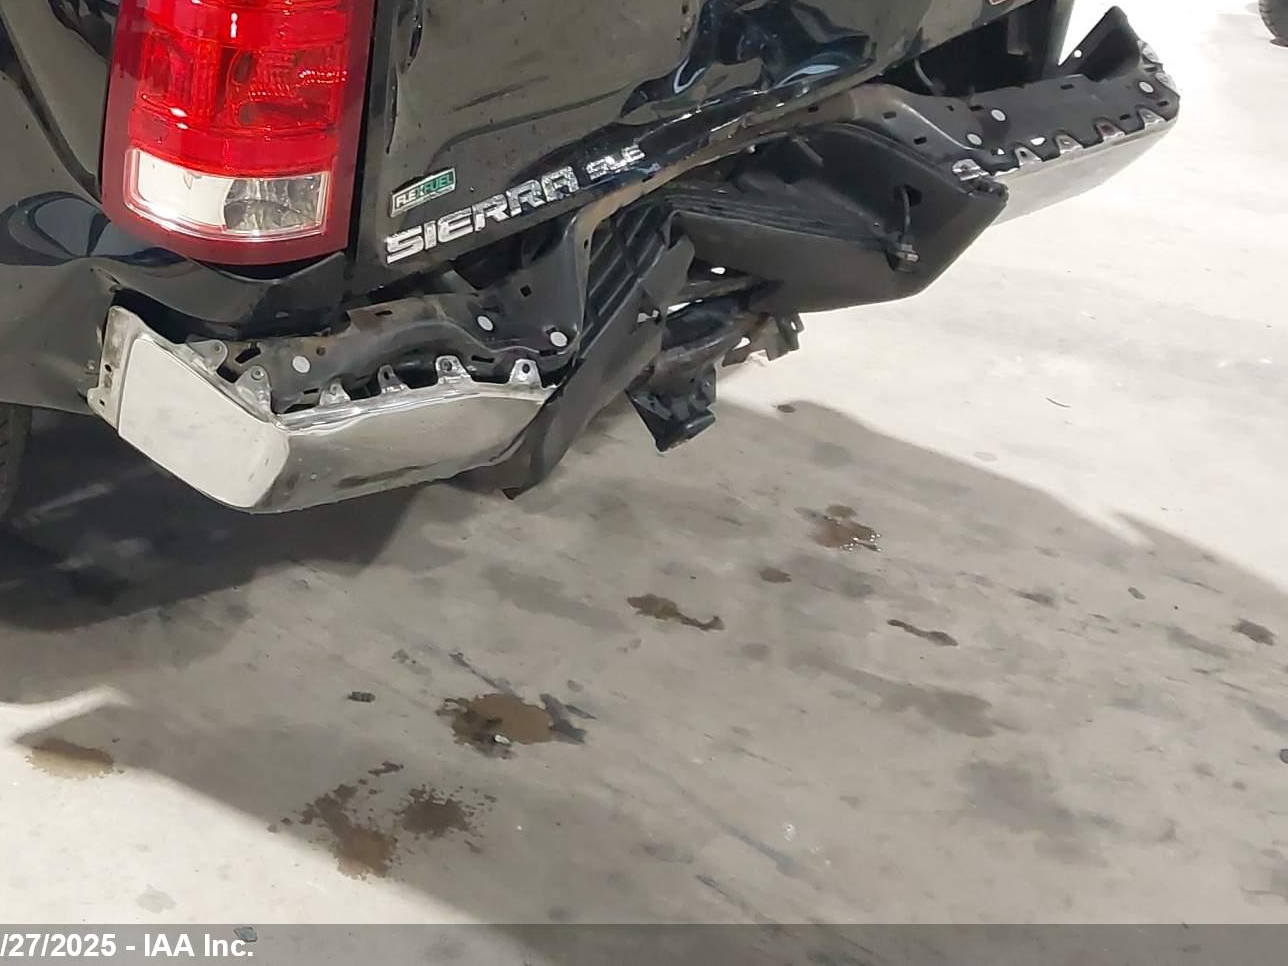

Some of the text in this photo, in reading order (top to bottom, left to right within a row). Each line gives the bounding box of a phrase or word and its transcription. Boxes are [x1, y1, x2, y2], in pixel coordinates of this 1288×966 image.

[384, 144, 645, 264] SIERRA SLE
[394, 173, 453, 208] FLEXFUEL
